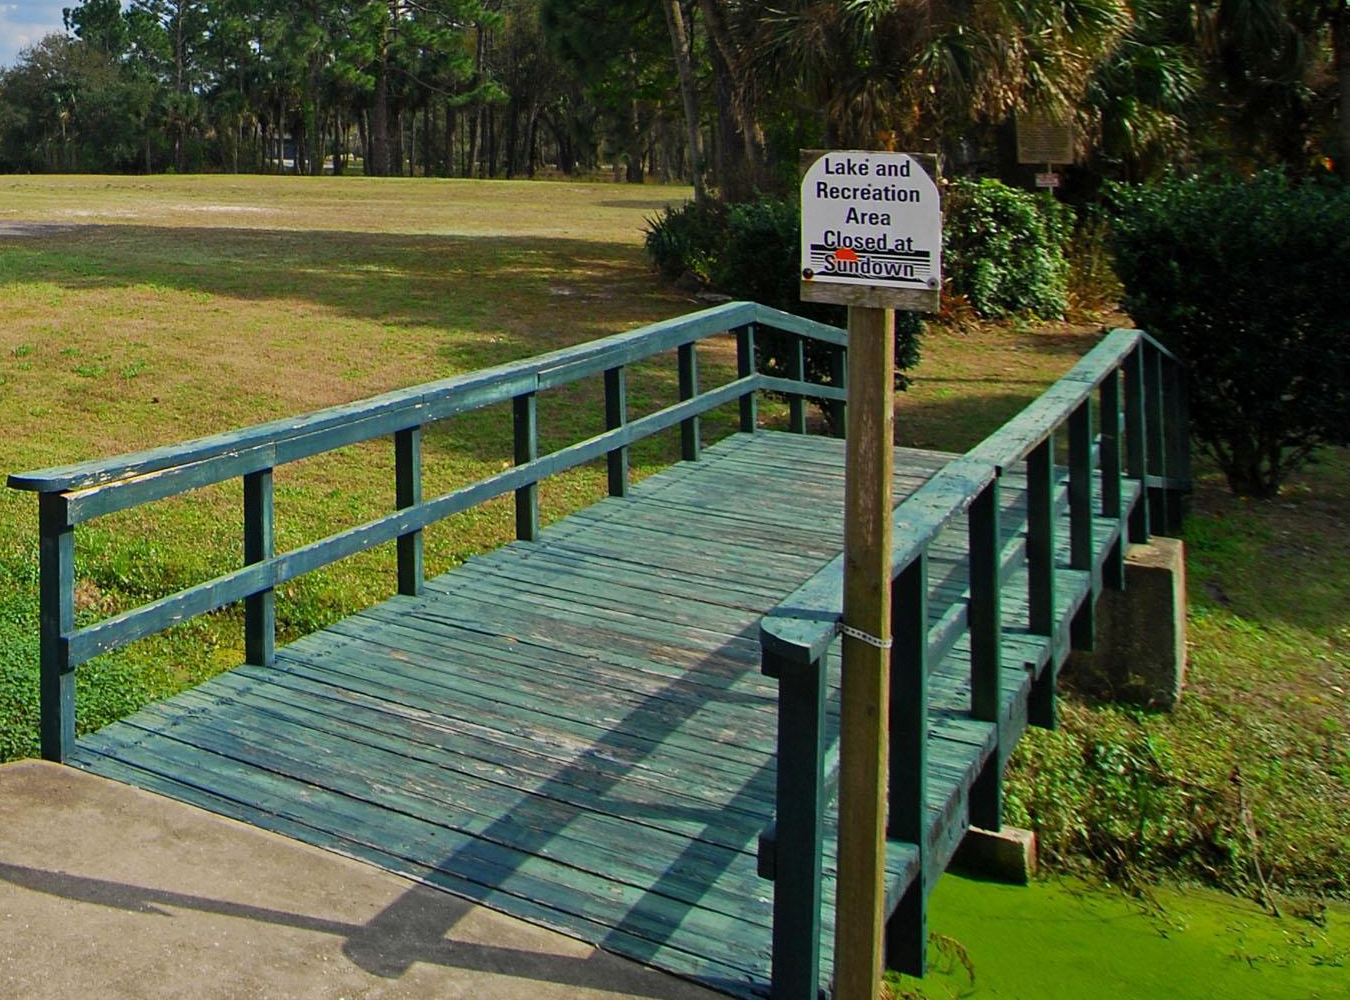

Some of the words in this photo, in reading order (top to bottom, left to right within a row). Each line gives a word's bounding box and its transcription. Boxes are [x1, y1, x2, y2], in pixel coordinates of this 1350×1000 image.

[825, 158, 869, 176] Lake
[876, 160, 910, 177] and
[816, 181, 920, 202] Recreation
[845, 207, 891, 226] Area
[824, 230, 887, 251] Closed
[895, 237, 913, 252] at
[824, 255, 914, 277] Sundown
